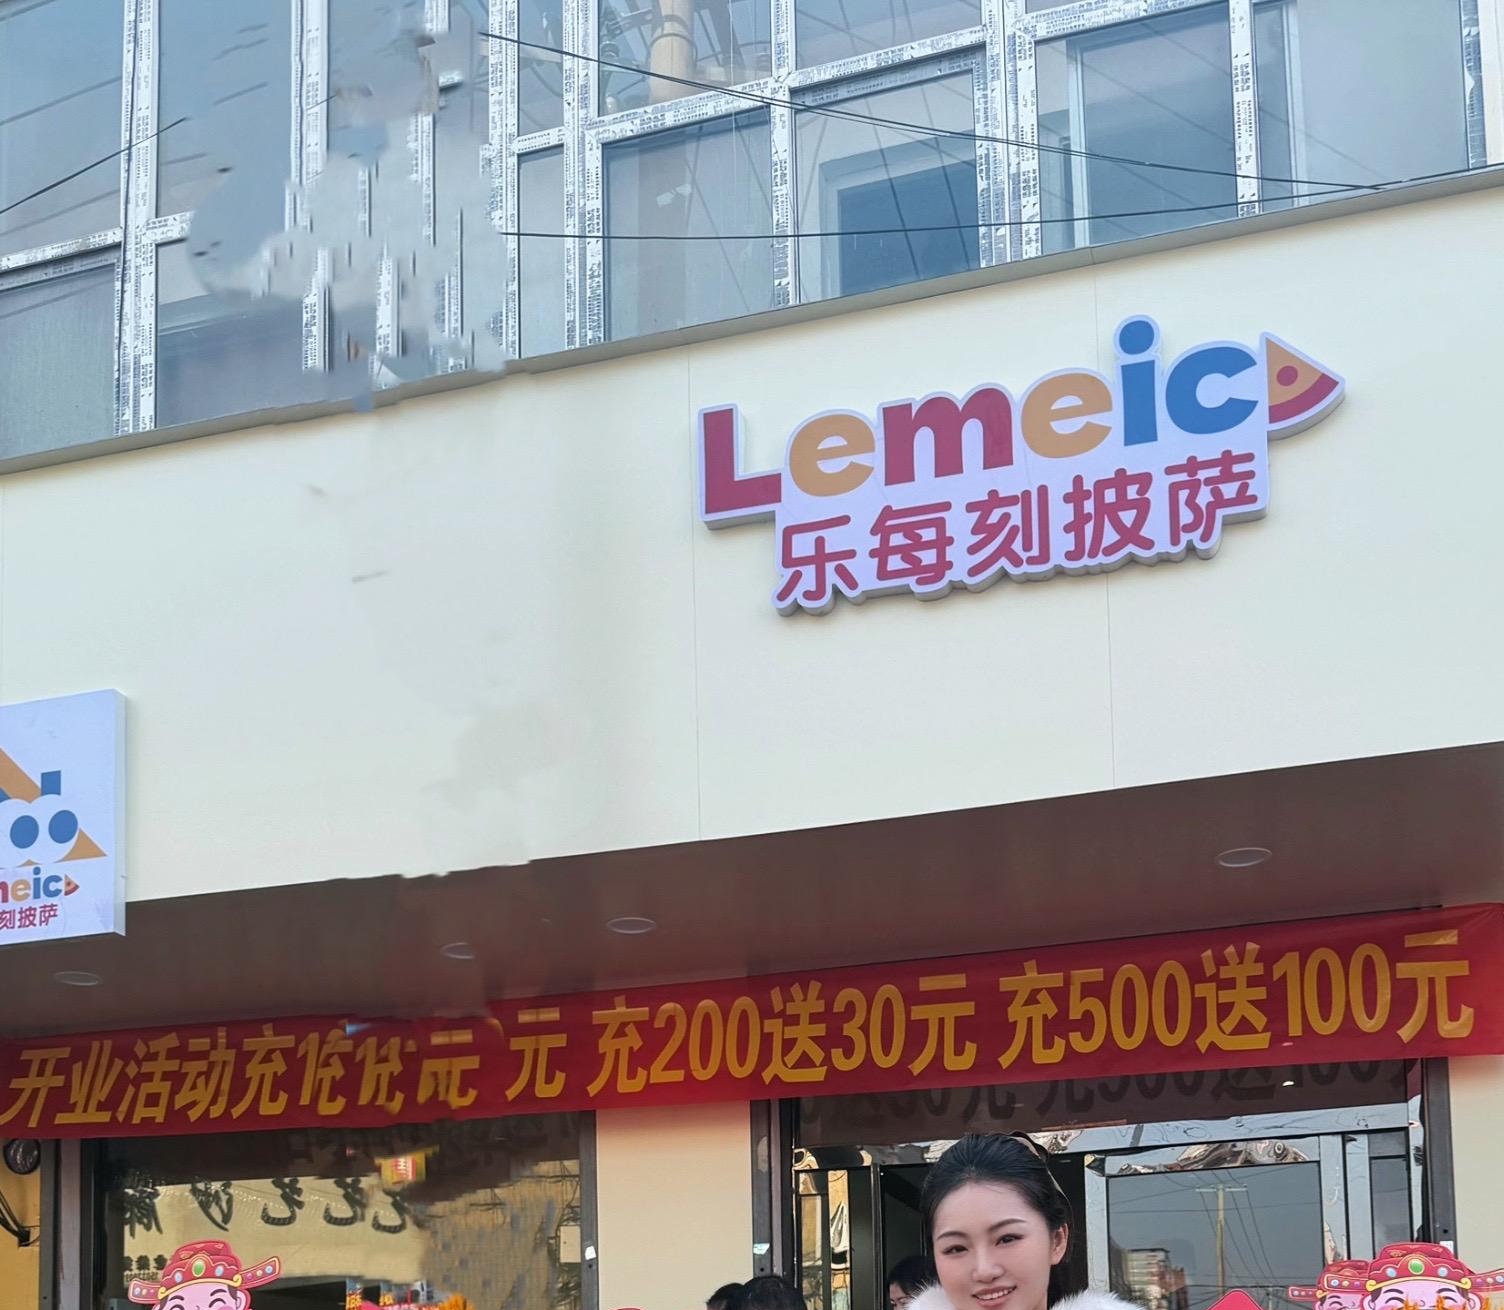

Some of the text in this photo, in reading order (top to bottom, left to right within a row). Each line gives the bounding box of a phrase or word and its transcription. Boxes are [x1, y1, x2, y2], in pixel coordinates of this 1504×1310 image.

[703, 320, 1258, 514] Lemeic
[776, 449, 1258, 602] 乐每刻披萨
[586, 973, 977, 1097] 充200送30元
[998, 928, 1475, 1070] 充500送100元
